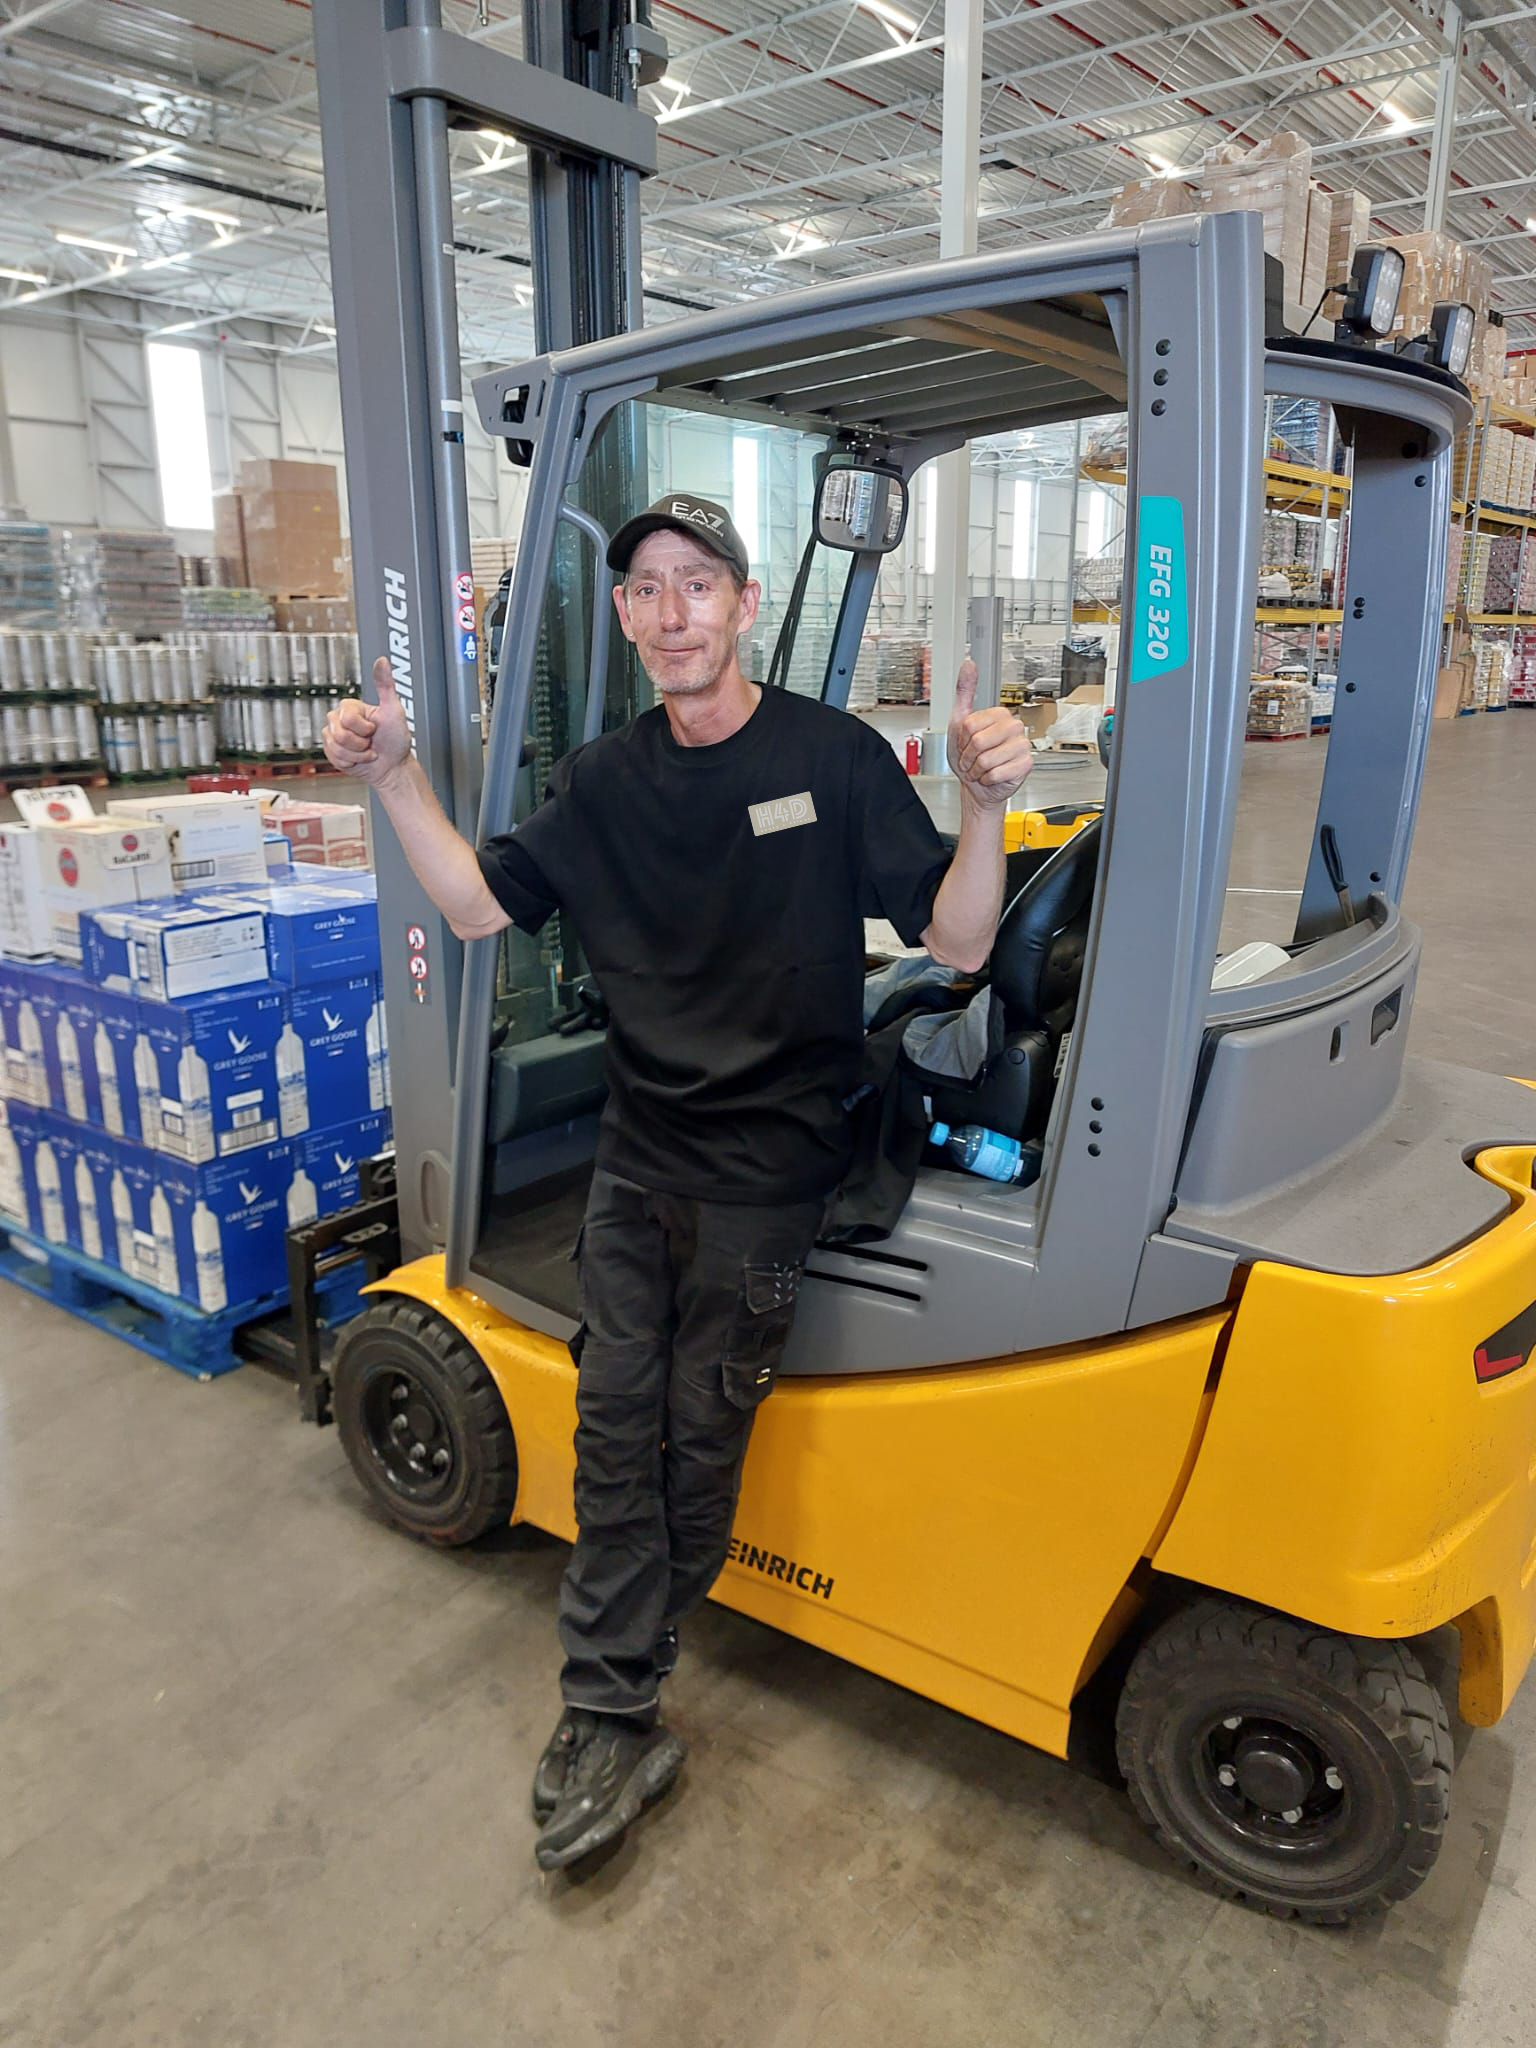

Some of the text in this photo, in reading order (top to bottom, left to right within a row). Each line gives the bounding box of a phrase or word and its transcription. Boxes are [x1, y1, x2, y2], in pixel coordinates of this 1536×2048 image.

[671, 501, 725, 529] EA7
[1146, 543, 1173, 661] EFG 320
[384, 566, 418, 761] EINRICH
[755, 798, 808, 829] H4D
[309, 1036, 330, 1047] GREY
[331, 1029, 358, 1042] GOOSE
[213, 1058, 236, 1071] GREY
[238, 1051, 268, 1065] GOOSE
